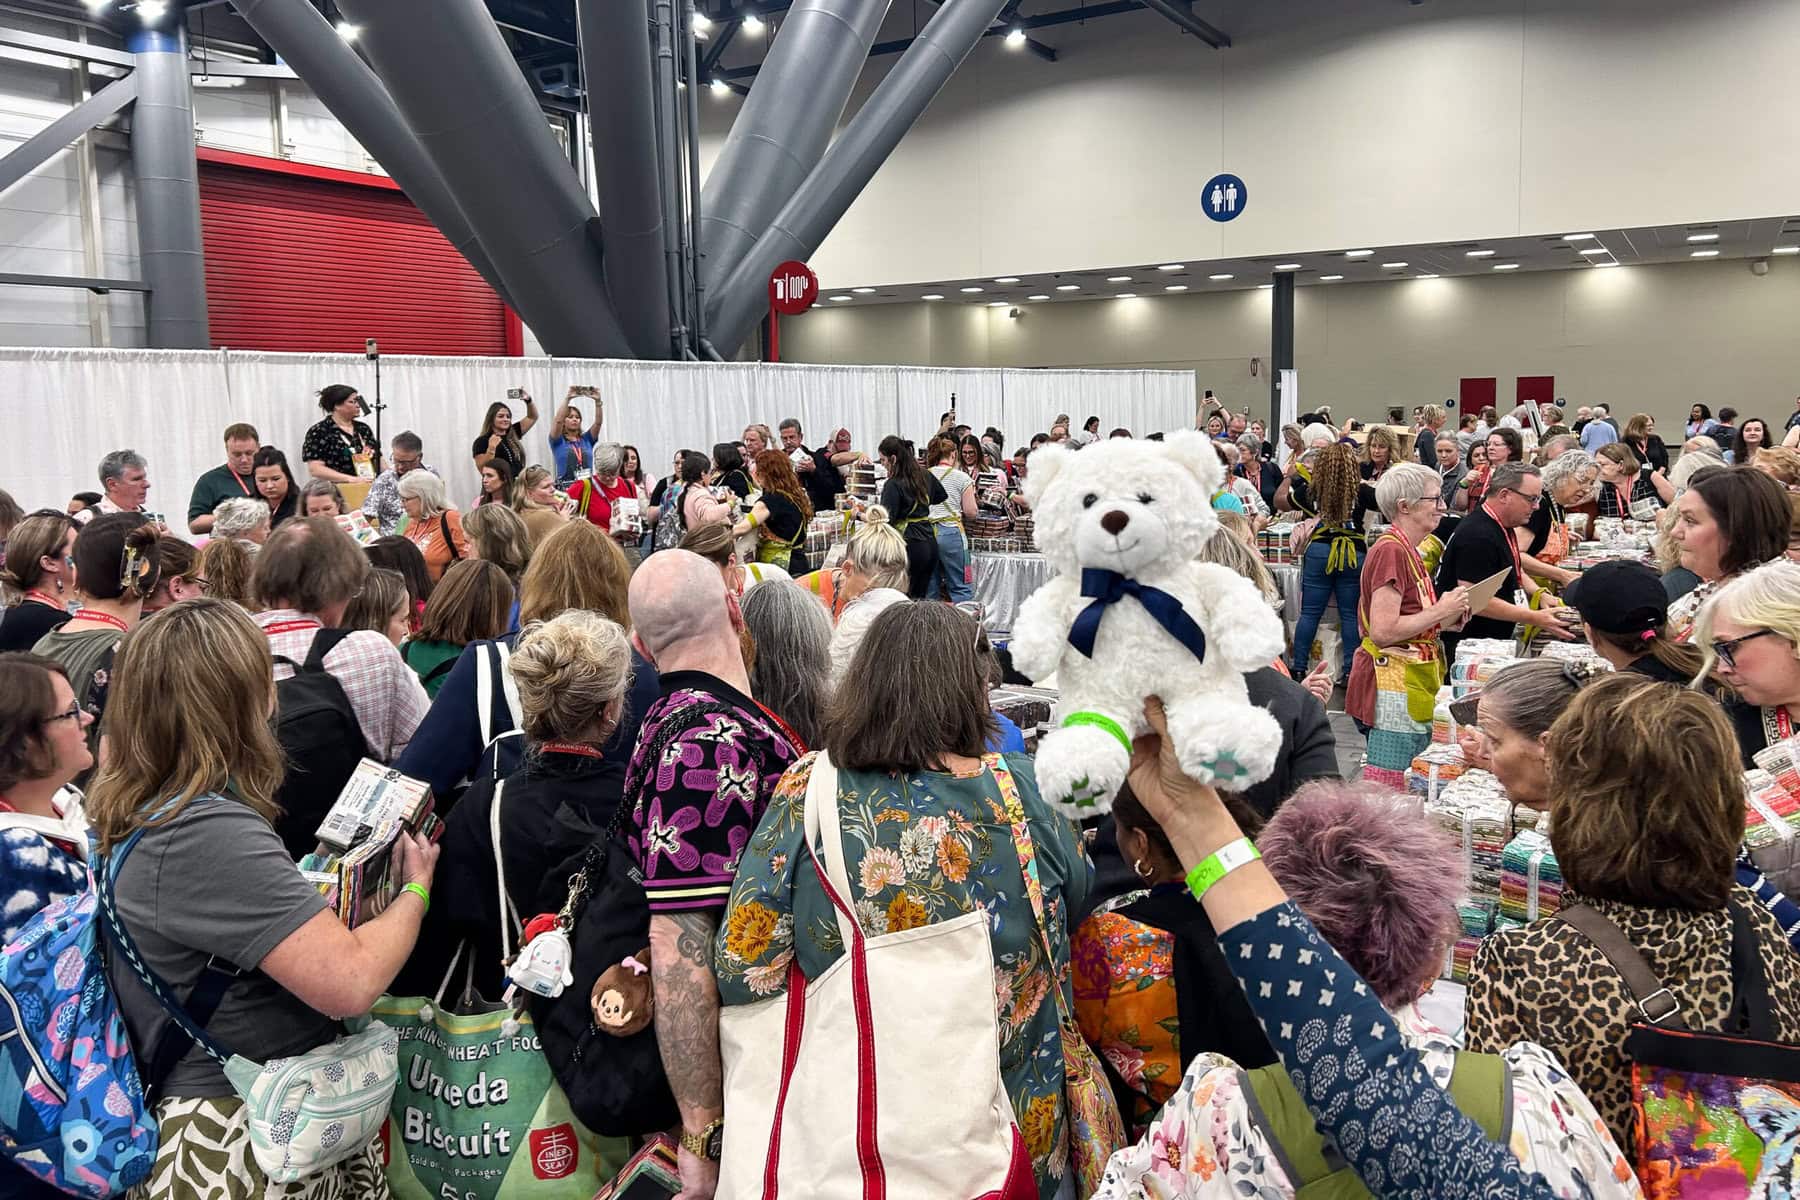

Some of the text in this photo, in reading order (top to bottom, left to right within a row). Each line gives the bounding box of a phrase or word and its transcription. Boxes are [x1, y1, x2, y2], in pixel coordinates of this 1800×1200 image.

[393, 1026, 413, 1040] HE
[403, 1106, 511, 1157] Biscuit
[454, 1168, 502, 1180] Packages
